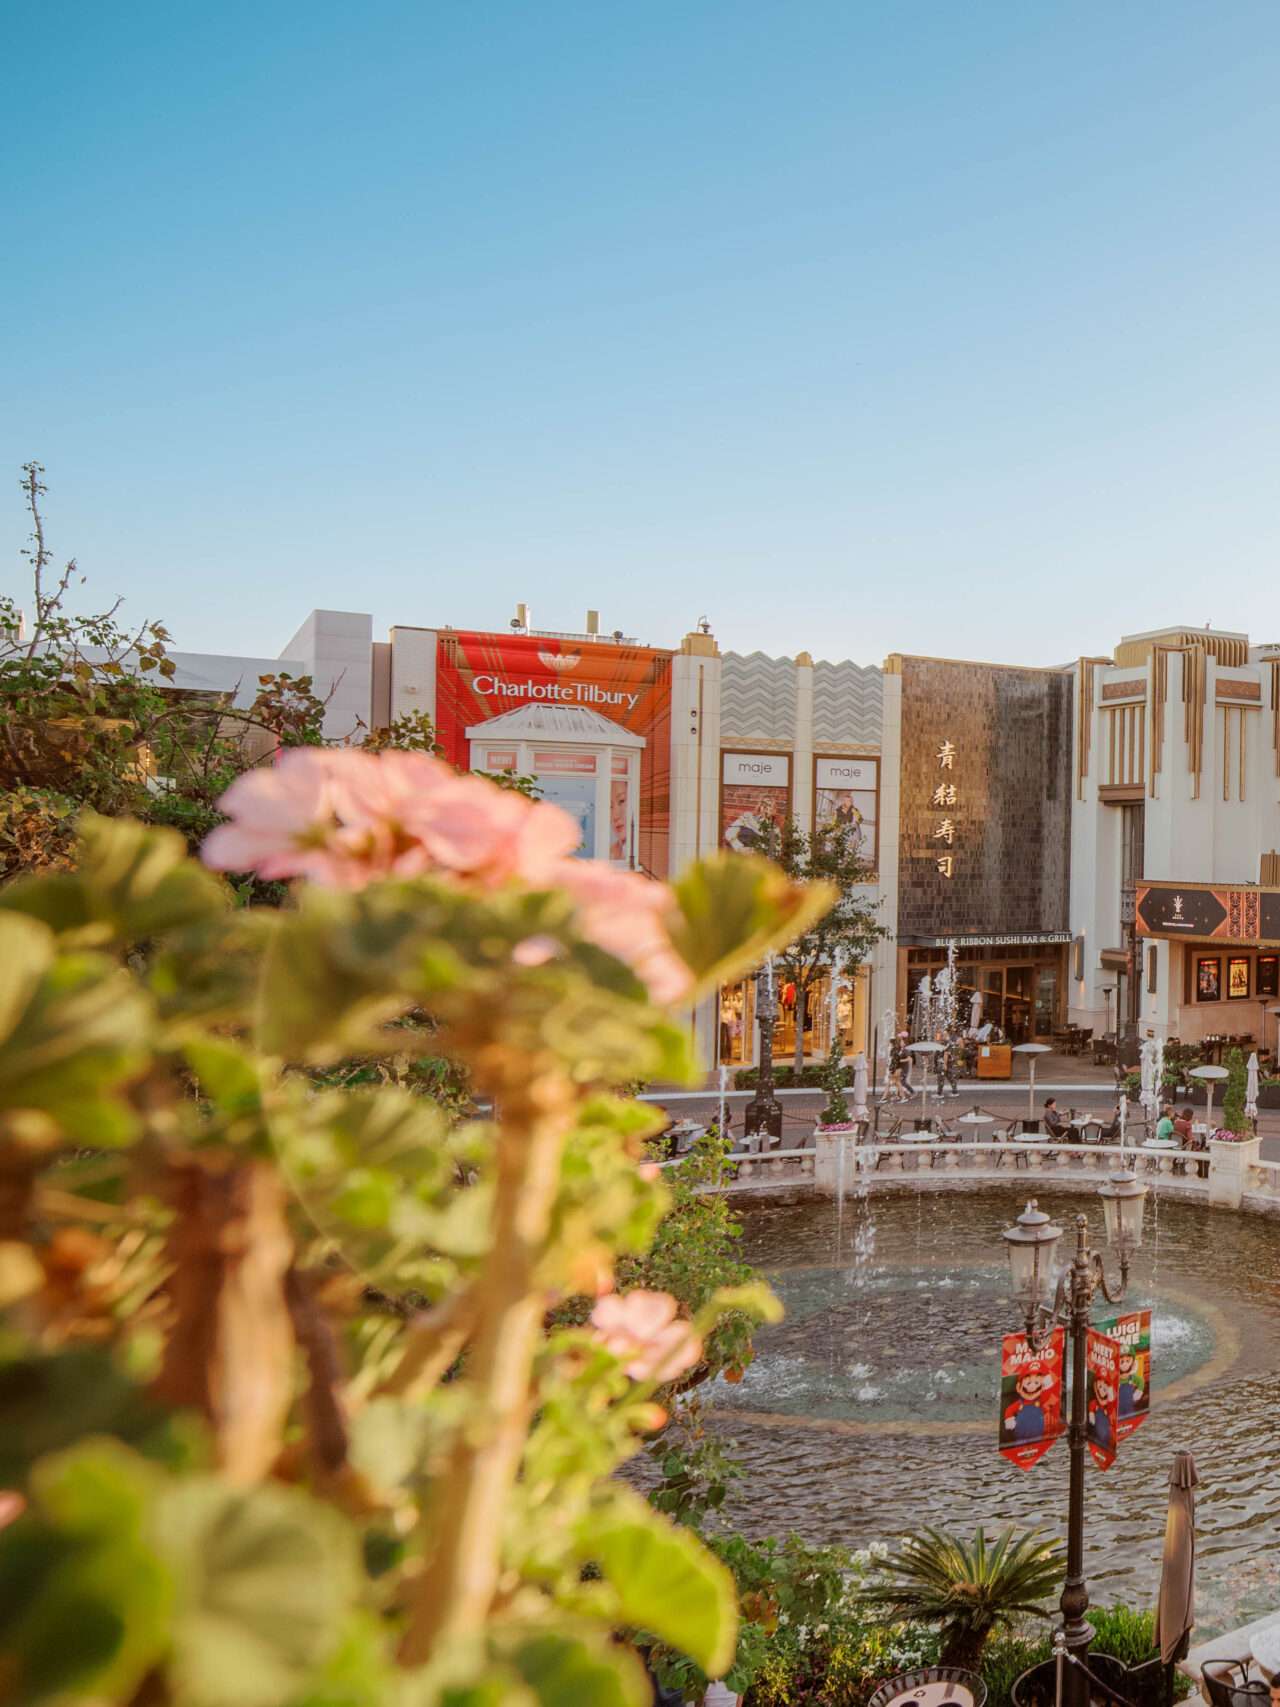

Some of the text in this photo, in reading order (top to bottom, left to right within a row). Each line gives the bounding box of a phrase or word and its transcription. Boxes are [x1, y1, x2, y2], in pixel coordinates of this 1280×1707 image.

[738, 762, 773, 774] maje
[830, 766, 862, 778] maje
[935, 938, 958, 947] BLUE
[960, 937, 993, 946] RIBBON
[995, 936, 1020, 945] SUSHI
[1022, 935, 1038, 944] BAR
[1048, 934, 1071, 943] GRILL
